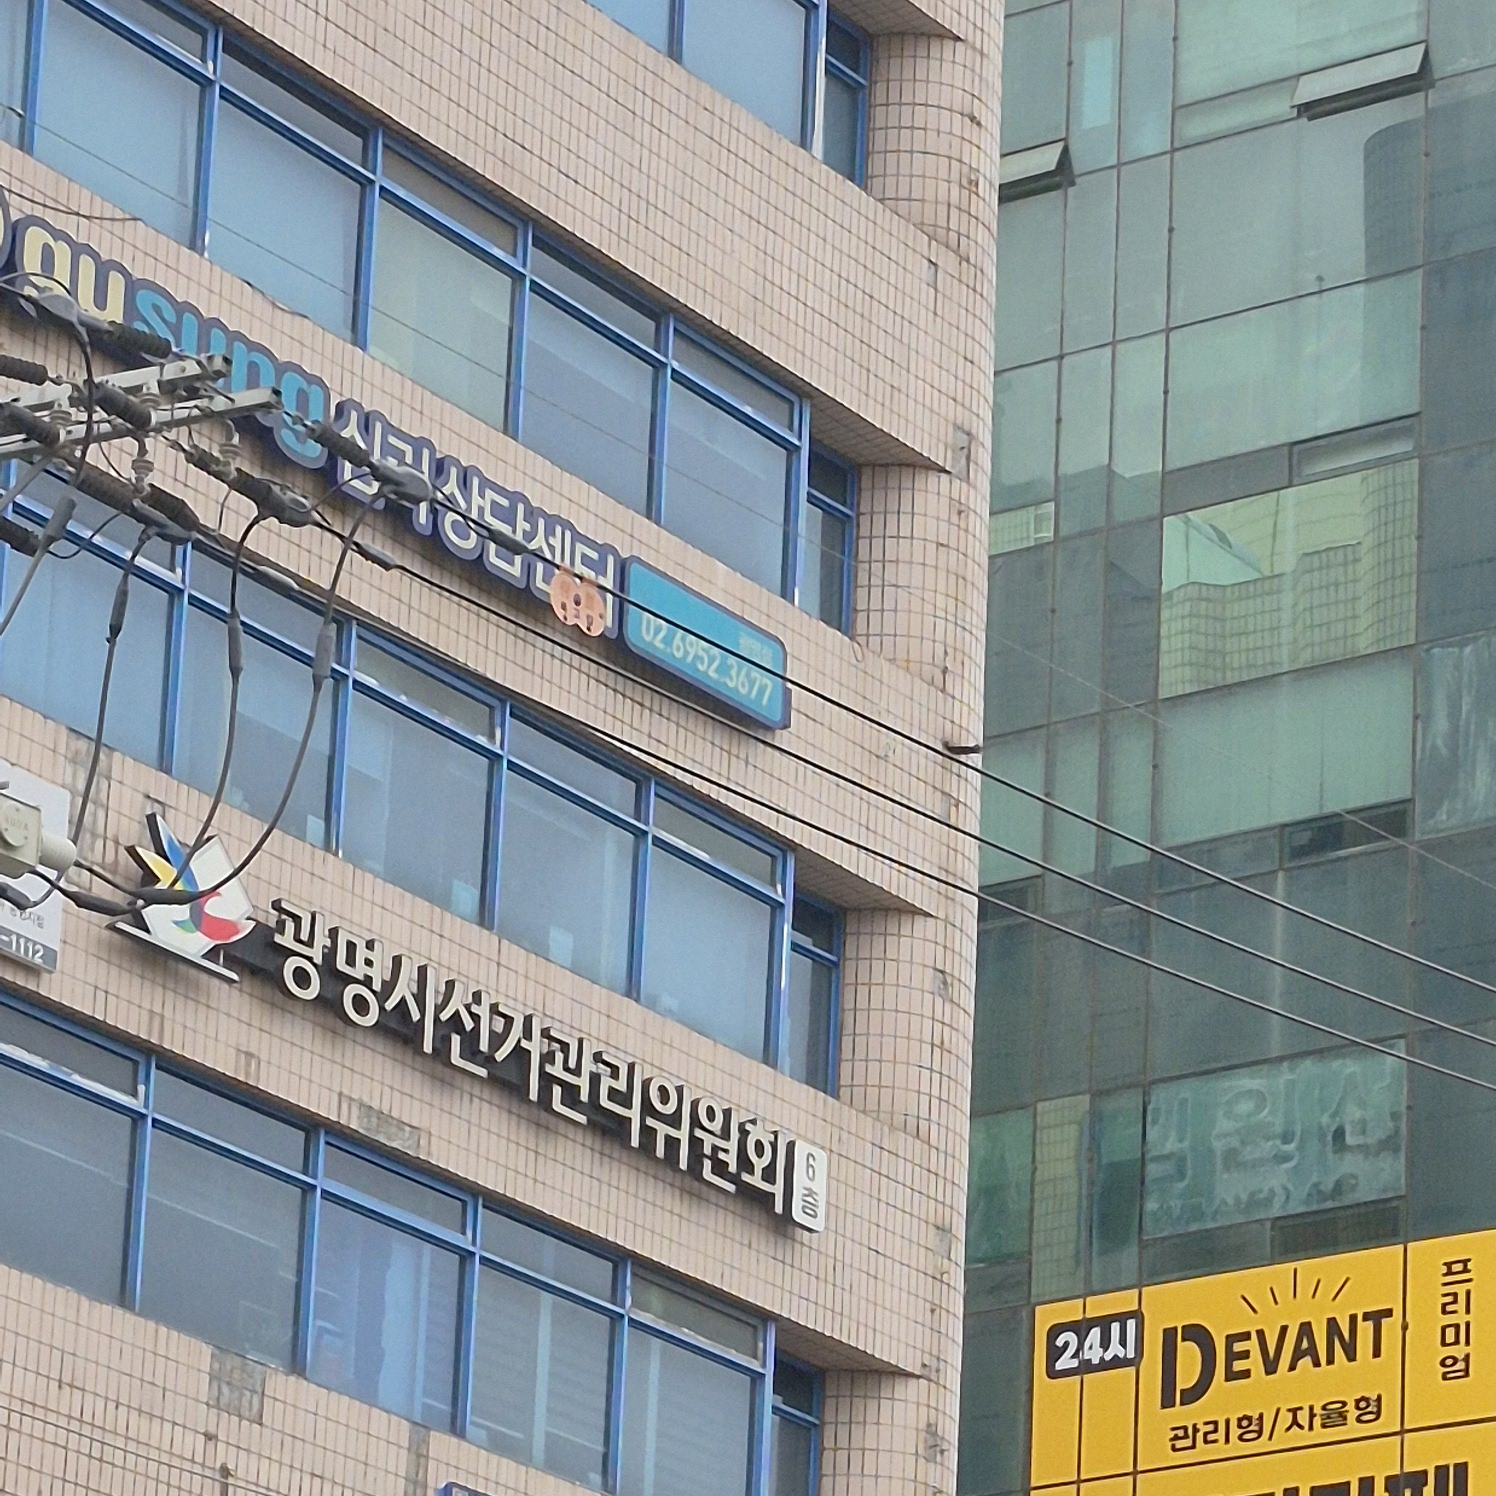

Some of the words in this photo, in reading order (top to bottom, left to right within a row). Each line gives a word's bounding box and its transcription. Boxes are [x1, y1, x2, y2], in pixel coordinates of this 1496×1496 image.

[270, 897, 787, 1216] 광명시선거관리위원회
[1054, 1317, 1137, 1371] 24시
[1159, 1307, 1394, 1411] DEVANT
[1439, 1257, 1474, 1381] 프리미엄
[1169, 1393, 1383, 1453] 관리형/자율형
